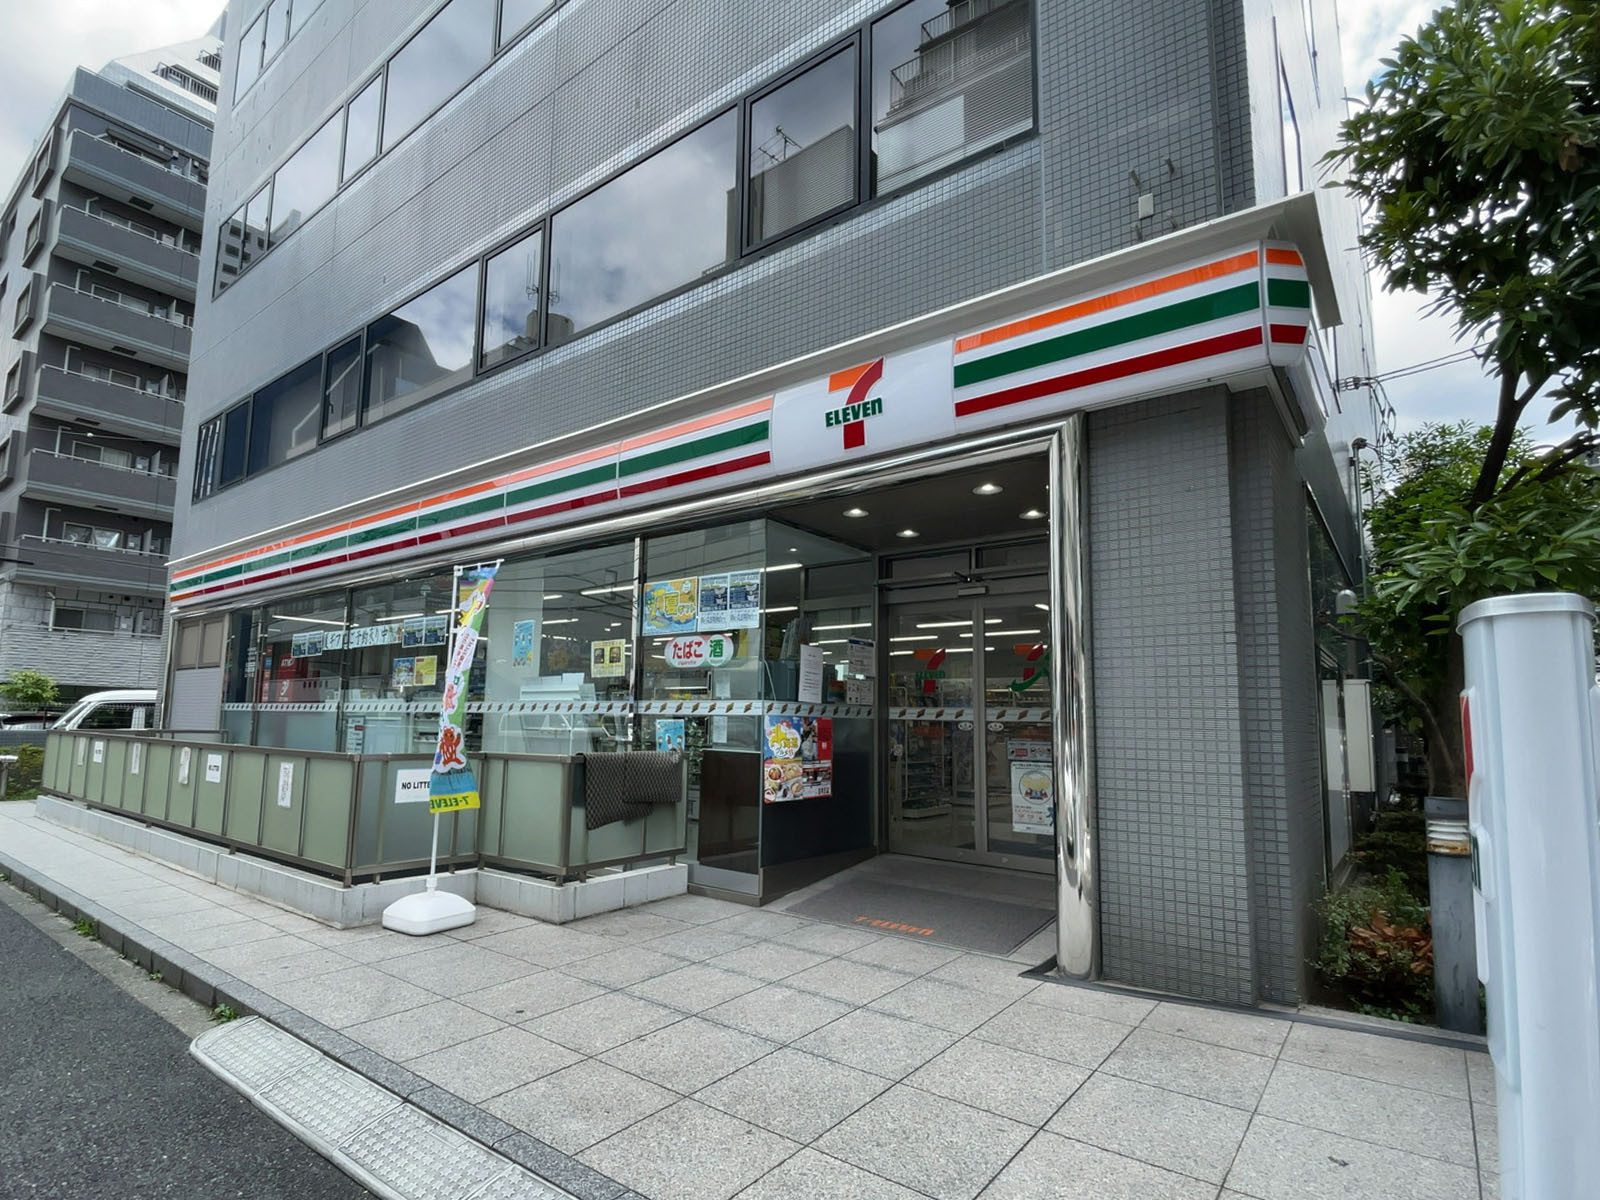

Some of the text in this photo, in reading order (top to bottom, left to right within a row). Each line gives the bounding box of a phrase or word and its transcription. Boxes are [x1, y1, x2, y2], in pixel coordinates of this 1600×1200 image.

[672, 641, 704, 659] たばこ
[709, 639, 724, 658] 酒
[401, 781, 412, 790] NO
